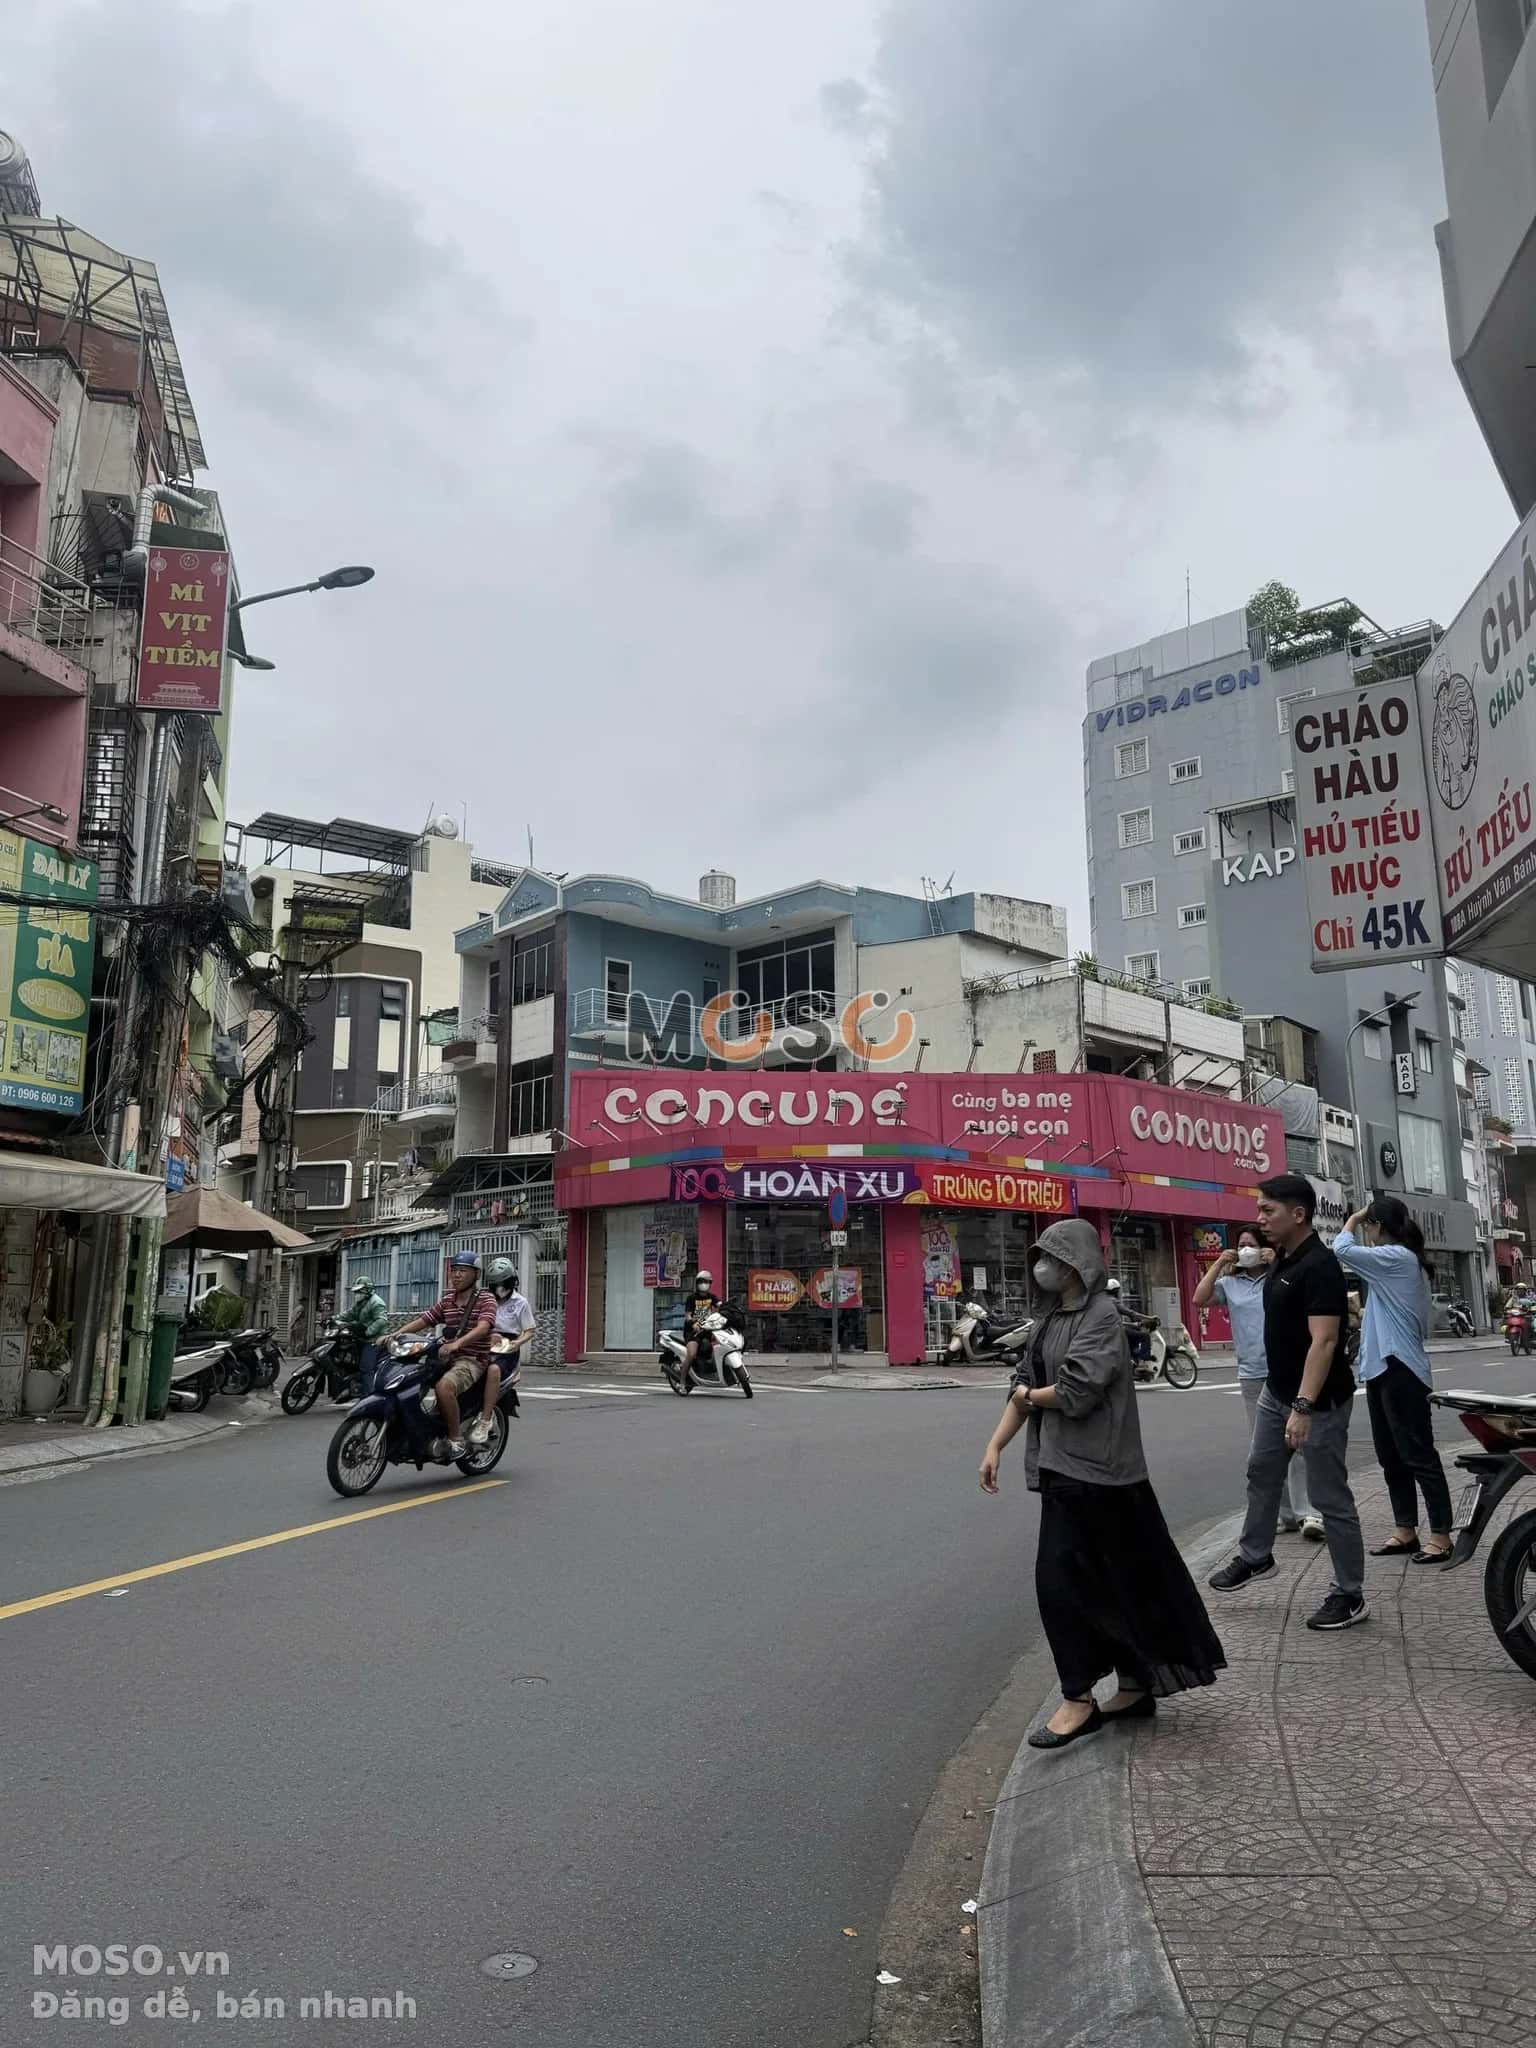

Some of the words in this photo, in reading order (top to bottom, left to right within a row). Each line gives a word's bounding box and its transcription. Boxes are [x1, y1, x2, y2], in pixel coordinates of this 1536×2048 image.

[169, 580, 205, 602] MÌ
[159, 612, 212, 636] VỊT
[145, 640, 220, 668] TIỀM
[1096, 664, 1261, 733] VIDRACON
[1488, 667, 1525, 729] CHÁO
[1295, 693, 1409, 753] CHÁO
[1313, 750, 1399, 804] HÀU
[1304, 811, 1346, 857] HỦ
[1352, 799, 1421, 849] TIẾU
[1443, 826, 1473, 898] HỦ
[1477, 777, 1532, 867] TIẾU
[32, 851, 65, 885] ĐẠI
[67, 865, 91, 891] LÝ
[1330, 853, 1402, 900] MỰC
[1493, 873, 1512, 899] Văn
[1314, 916, 1355, 952] Chỉ
[1362, 899, 1432, 950] 45K
[1400, 1055, 1411, 1090] KAPO
[17, 1087, 39, 1101] 0906
[41, 1091, 57, 1105] 600
[59, 1094, 75, 1107] 126
[952, 1092, 997, 1112] Cùng
[1001, 1088, 1031, 1108] ba
[1036, 1092, 1073, 1114] mẹ
[964, 1114, 1019, 1136] nuôi
[1023, 1119, 1069, 1136] con
[743, 1163, 846, 1197] HOÀN
[855, 1171, 904, 1198] XU
[932, 1173, 993, 1200] TRÚNG
